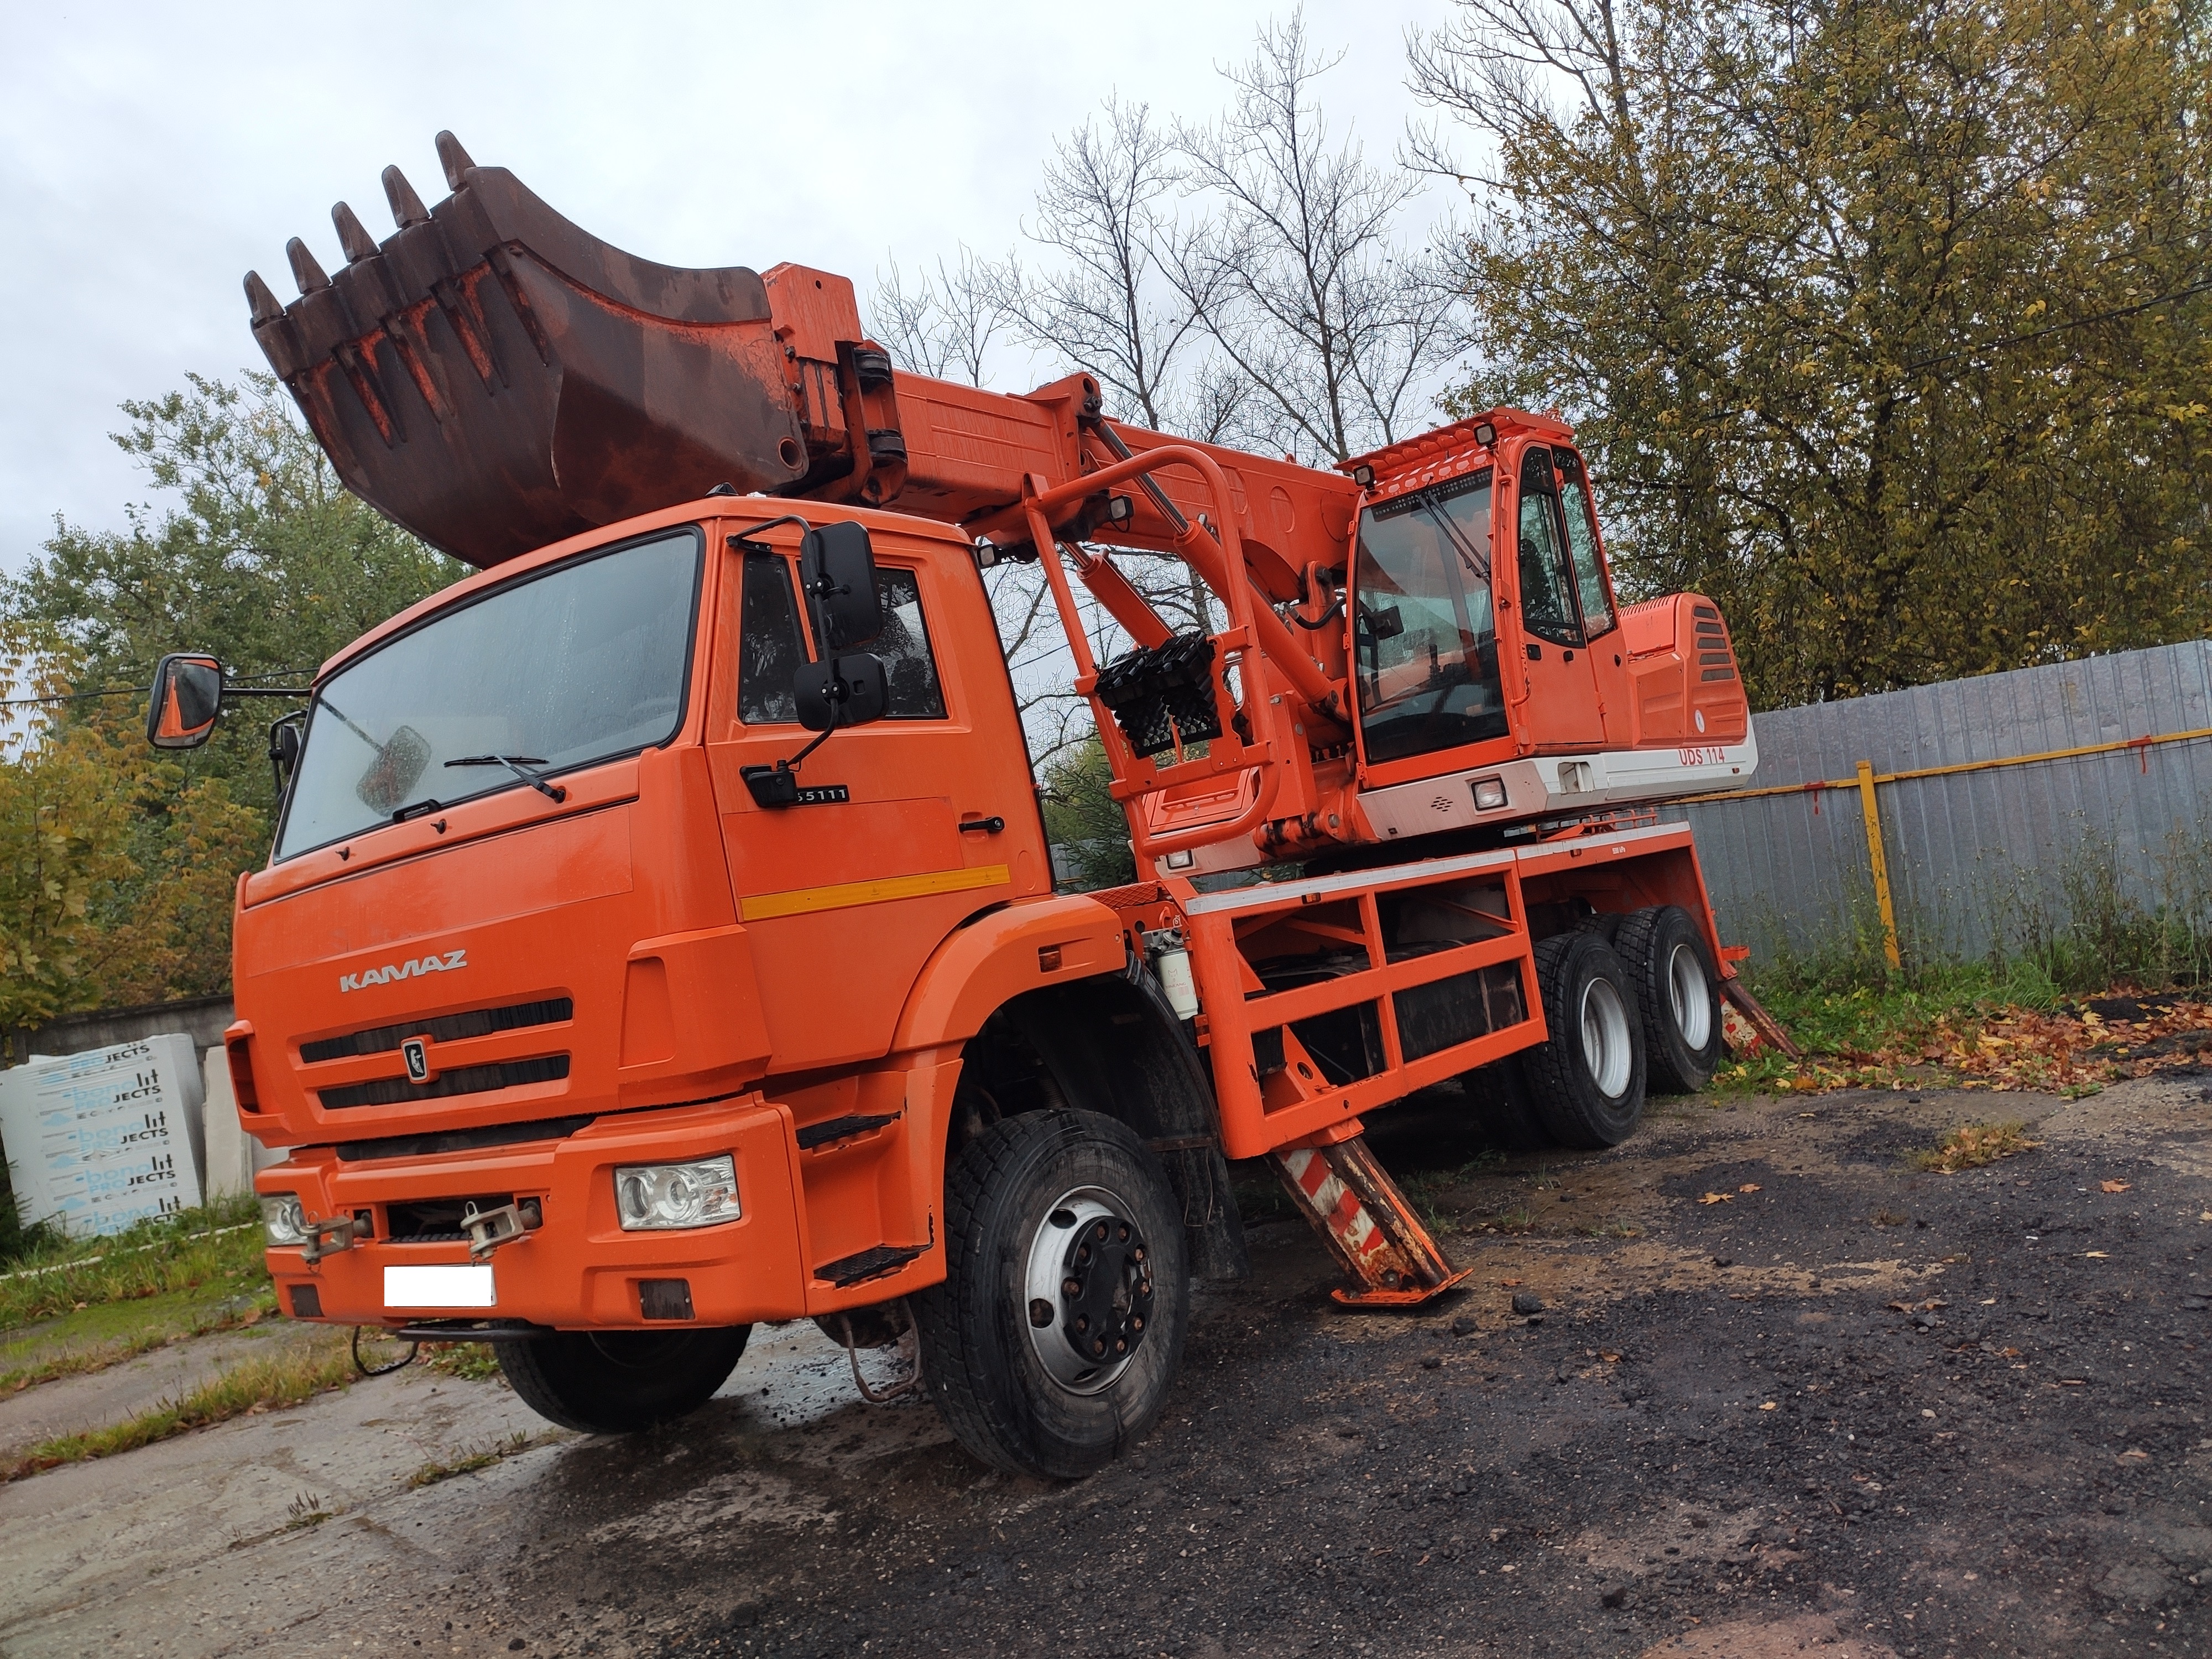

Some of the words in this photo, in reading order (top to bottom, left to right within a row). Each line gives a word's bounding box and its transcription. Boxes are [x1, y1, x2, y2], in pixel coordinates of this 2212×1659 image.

[1678, 749, 1703, 766] UDS
[1707, 747, 1725, 764] 114
[340, 949, 468, 993] KAMAZ
[79, 1111, 166, 1142] bonolit
[85, 1153, 173, 1183] bonolit
